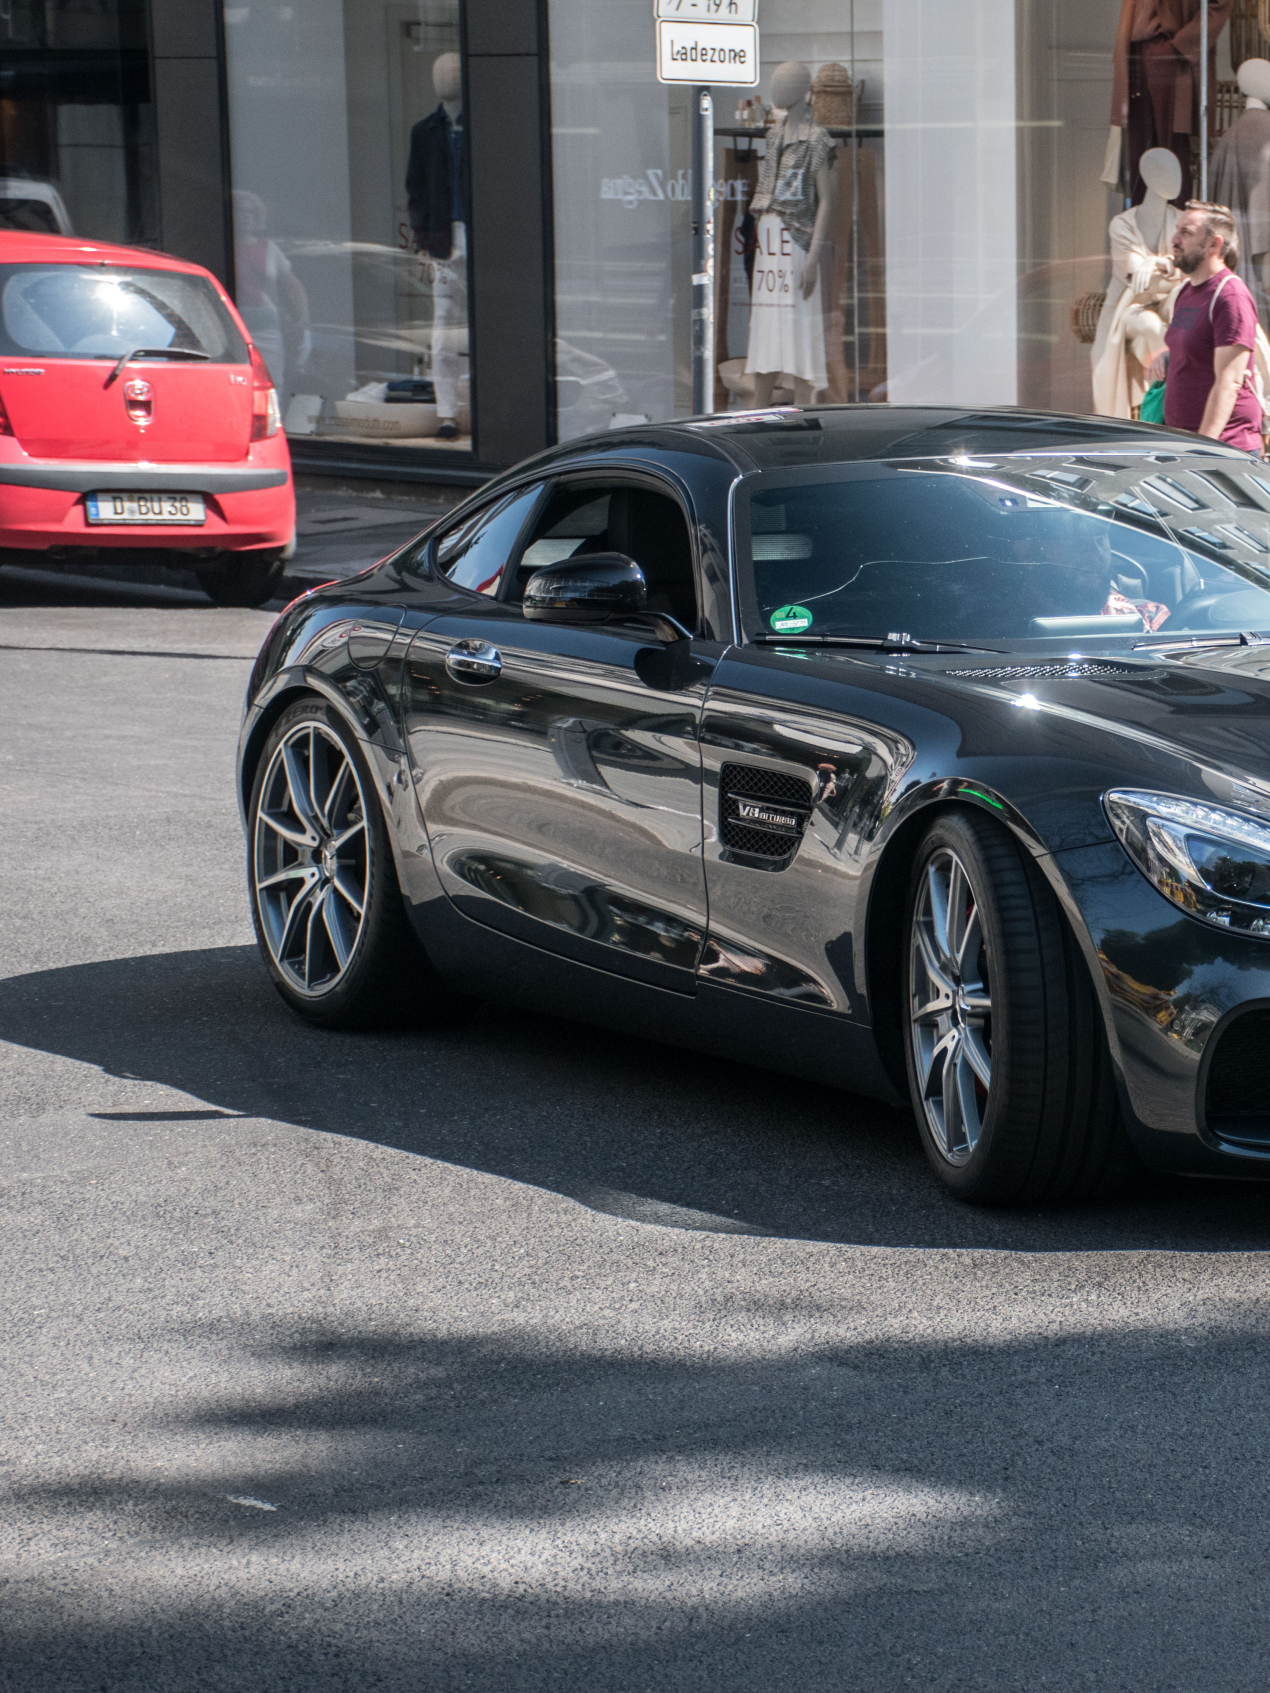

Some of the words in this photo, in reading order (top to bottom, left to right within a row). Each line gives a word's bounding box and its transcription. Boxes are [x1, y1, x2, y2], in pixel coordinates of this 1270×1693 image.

[670, 39, 747, 65] Ladezone
[734, 226, 792, 256] SALE
[112, 495, 125, 516] D
[138, 496, 163, 516] BU
[167, 496, 191, 517] 38
[785, 606, 799, 619] 4
[740, 803, 760, 818] V8
[759, 812, 796, 826] BITURBO
